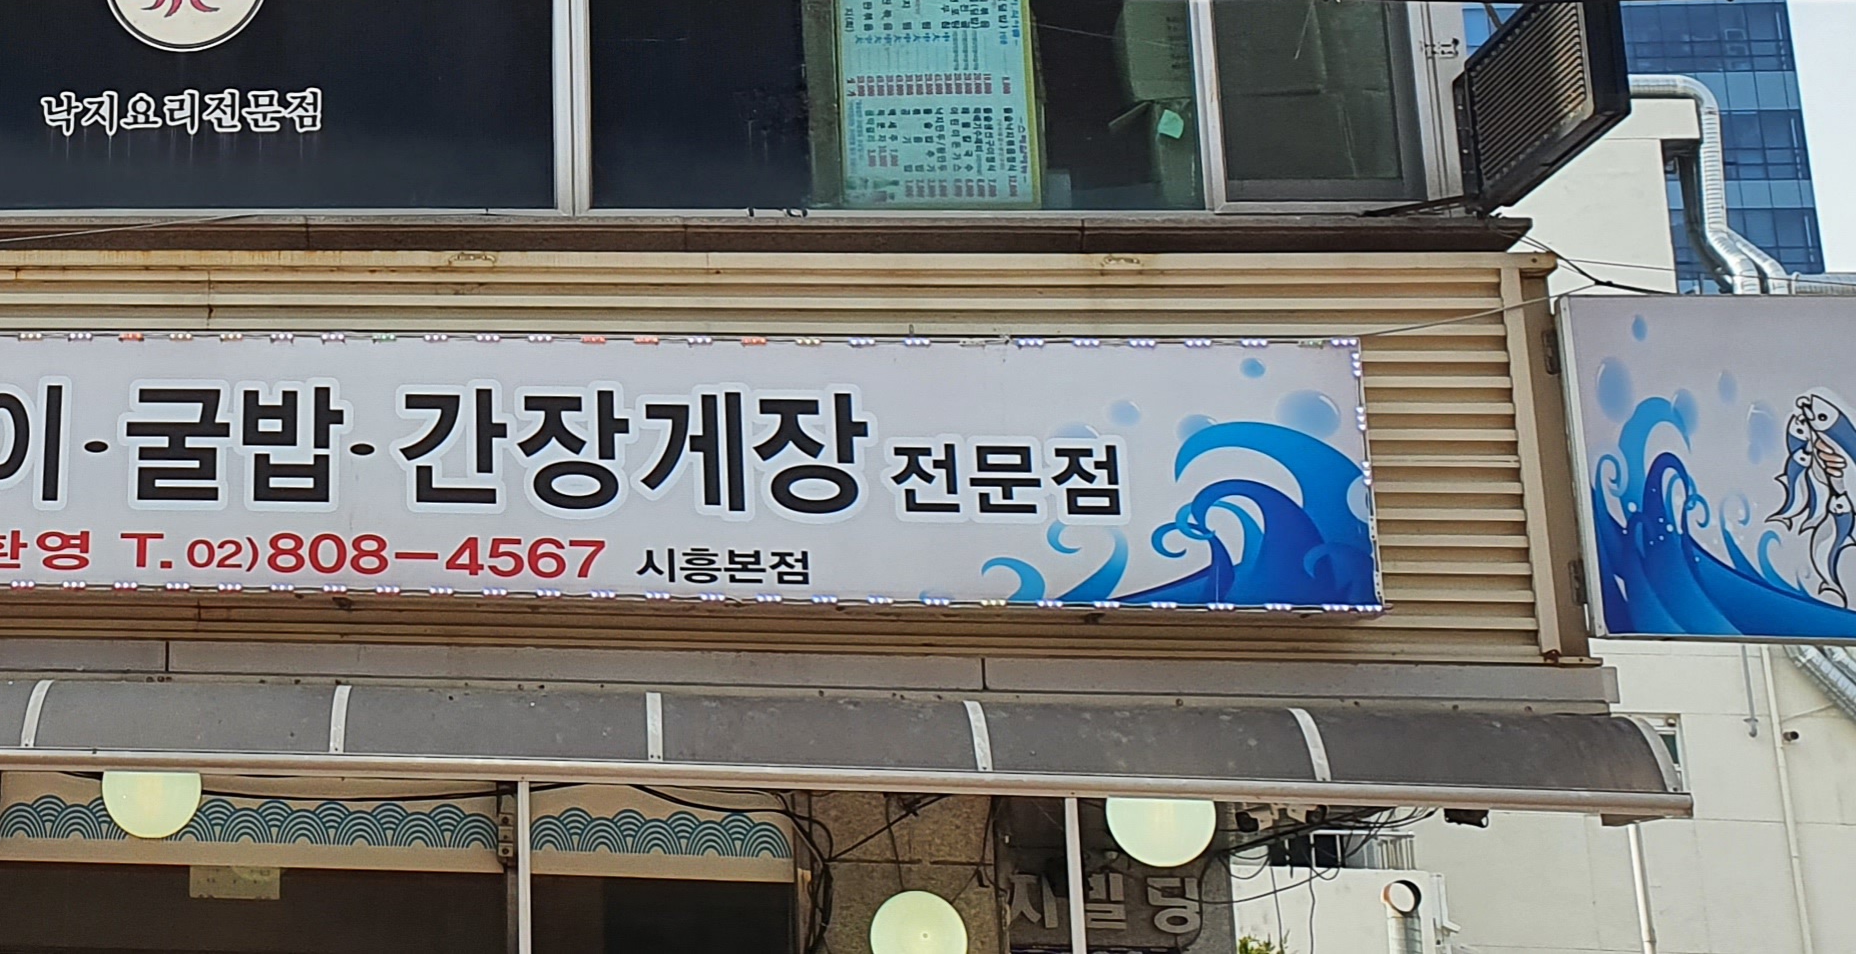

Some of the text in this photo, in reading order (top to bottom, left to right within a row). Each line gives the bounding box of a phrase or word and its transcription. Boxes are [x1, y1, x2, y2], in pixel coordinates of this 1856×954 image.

[40, 86, 323, 137] 낙지요리전문점
[891, 442, 1122, 516] 전문점
[635, 547, 811, 586] 시흥본점
